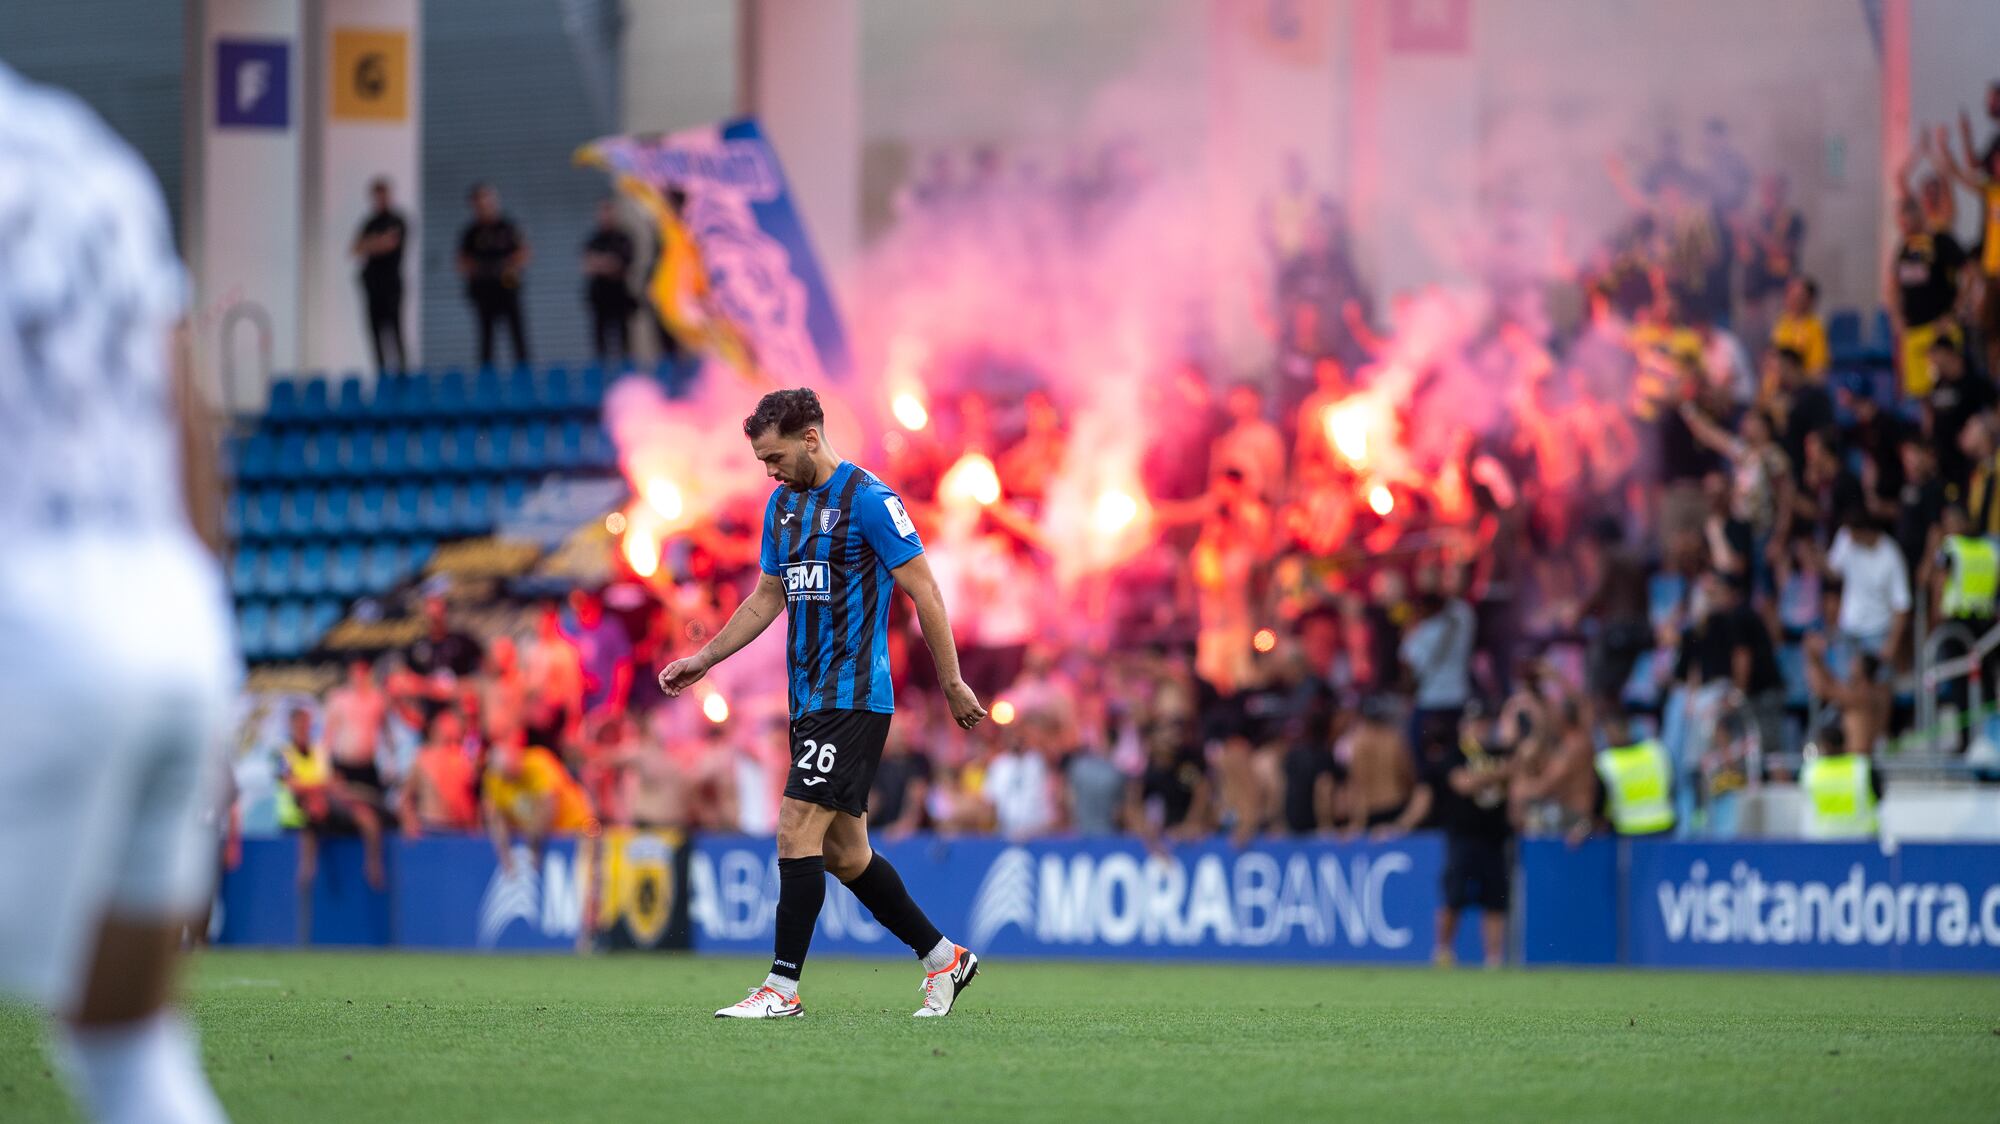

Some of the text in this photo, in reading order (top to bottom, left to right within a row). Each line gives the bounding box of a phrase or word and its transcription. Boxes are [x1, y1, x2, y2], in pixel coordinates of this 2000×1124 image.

[236, 60, 271, 114] F
[353, 52, 387, 101] G
[798, 739, 837, 773] 26
[1038, 850, 1413, 948] MORABANC
